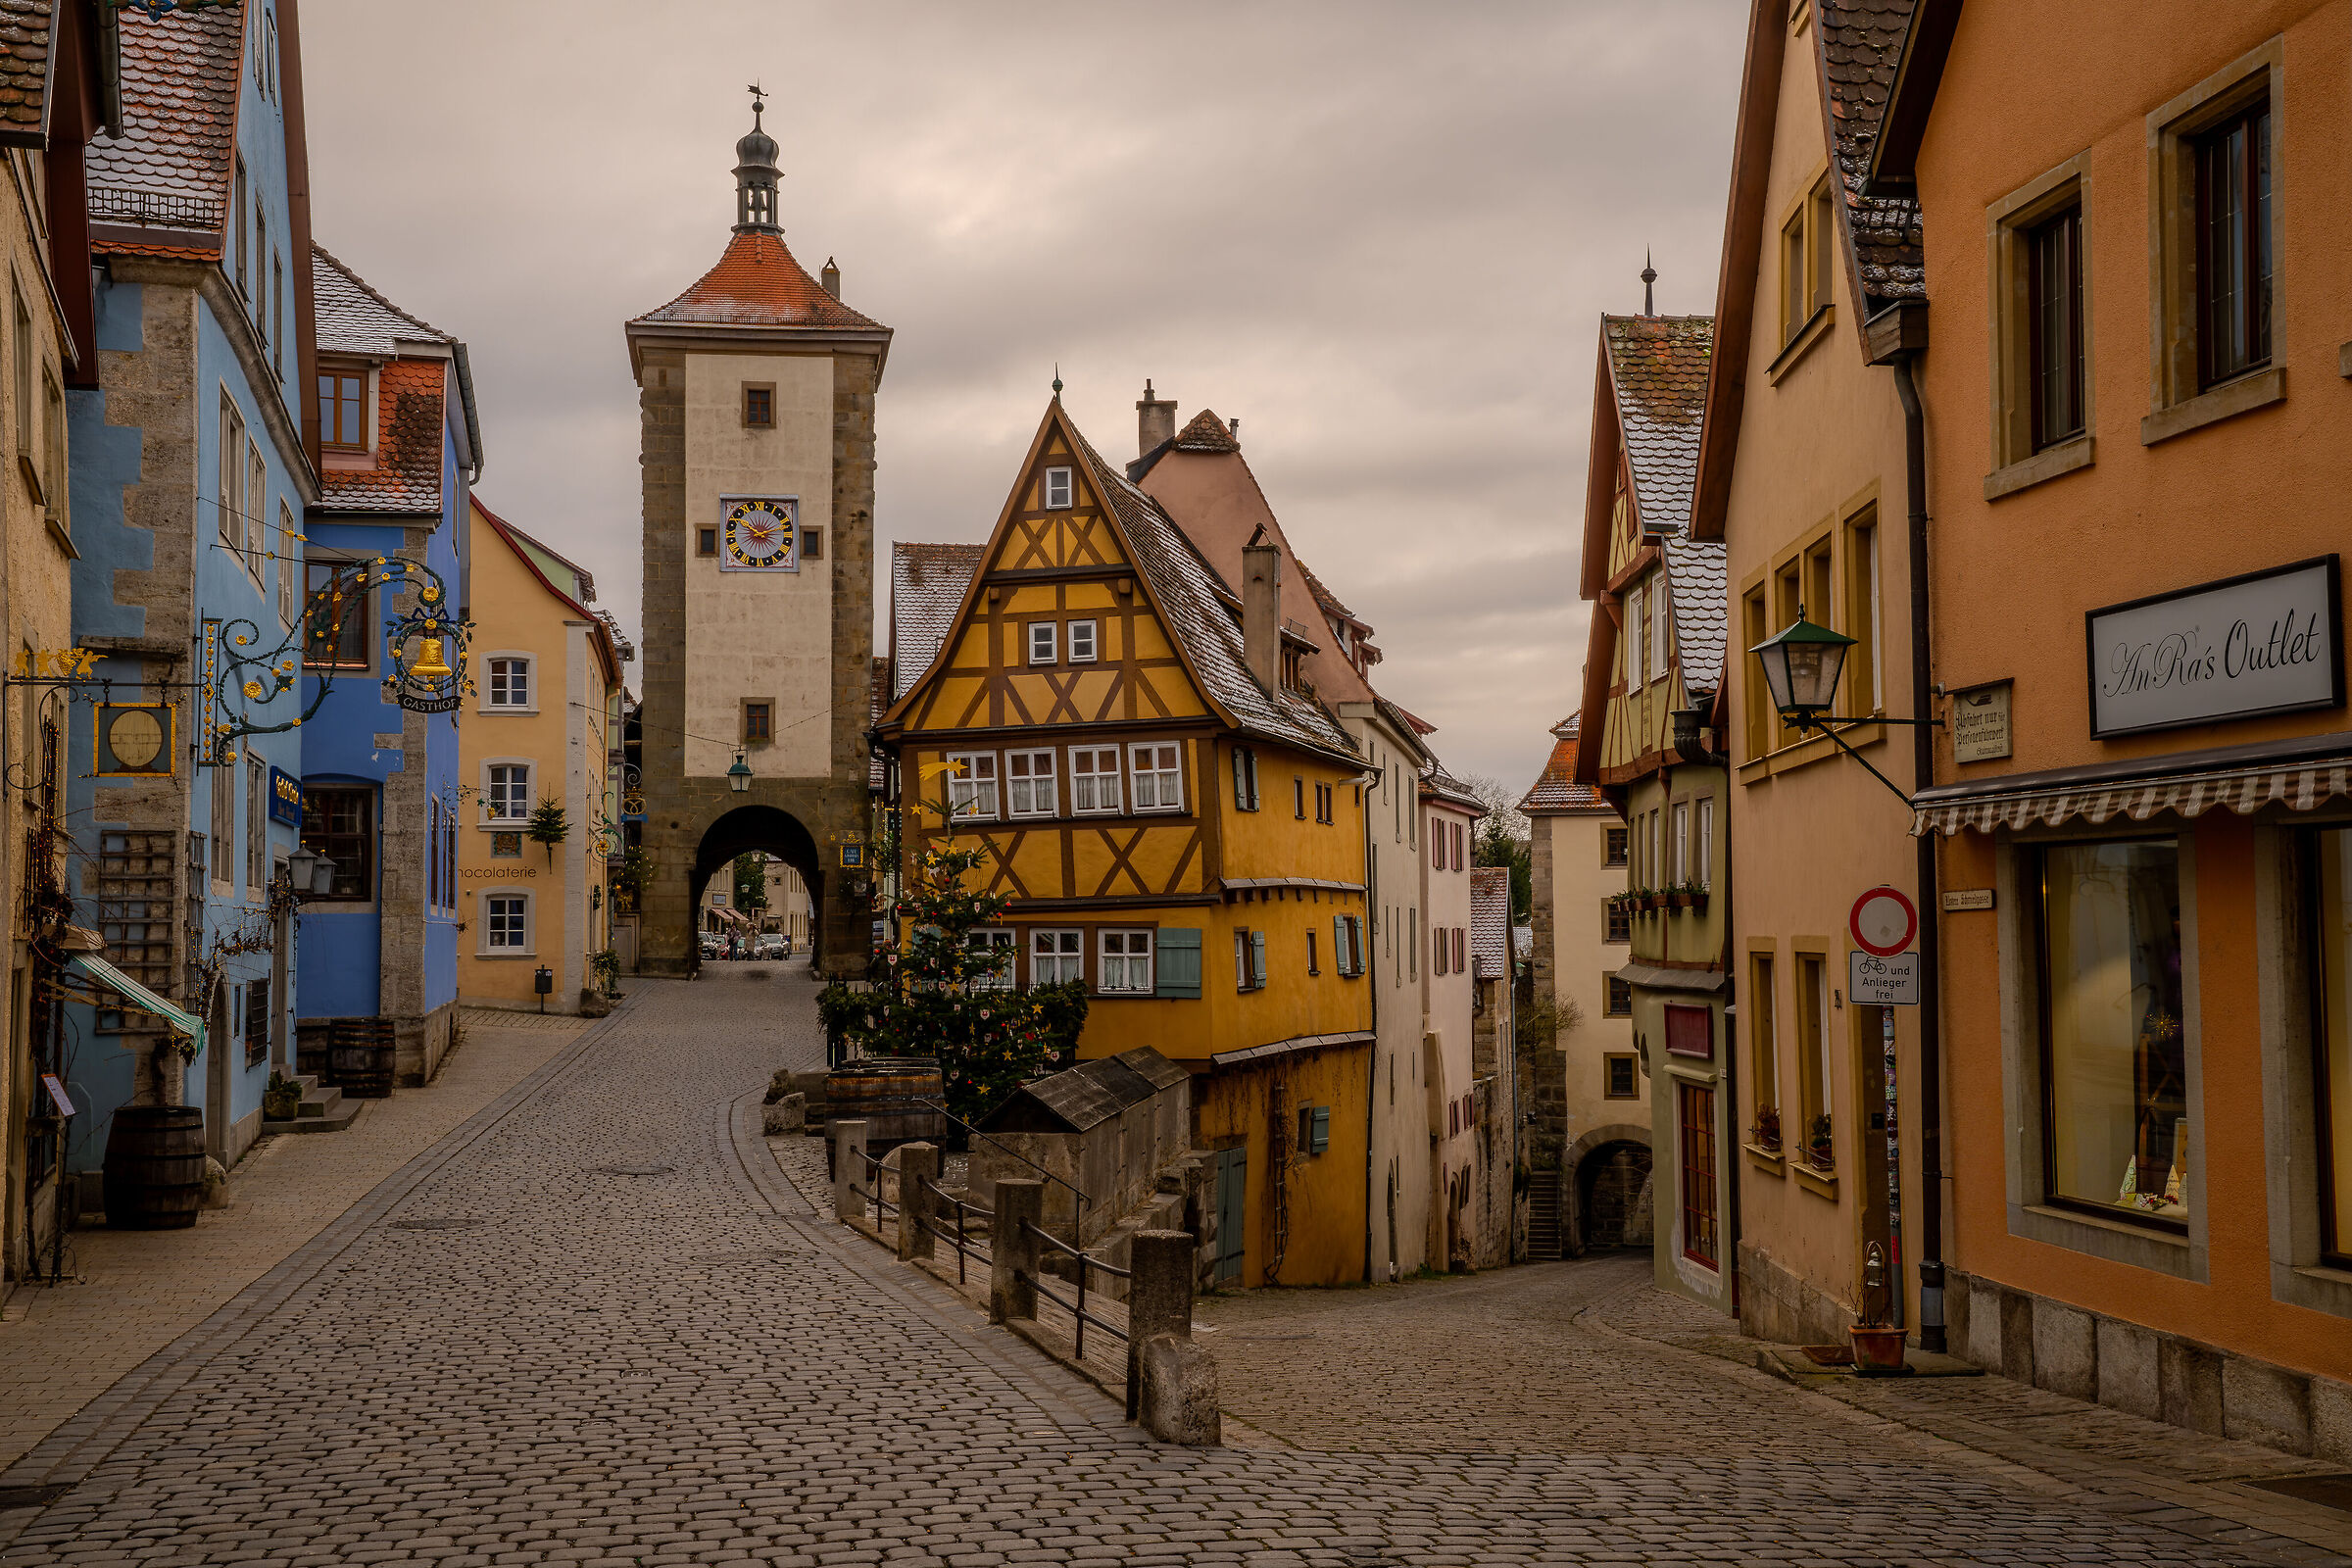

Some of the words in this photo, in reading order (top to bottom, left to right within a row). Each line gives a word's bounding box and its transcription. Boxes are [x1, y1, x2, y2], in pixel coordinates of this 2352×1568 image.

[754, 502, 764, 511] XII
[2224, 608, 2321, 679] Outlet
[403, 697, 457, 711] GASTHOF
[1984, 711, 1997, 723] nur
[1890, 965, 1910, 975] und
[1862, 977, 1907, 990] Anlieger
[1876, 989, 1893, 999] frei
